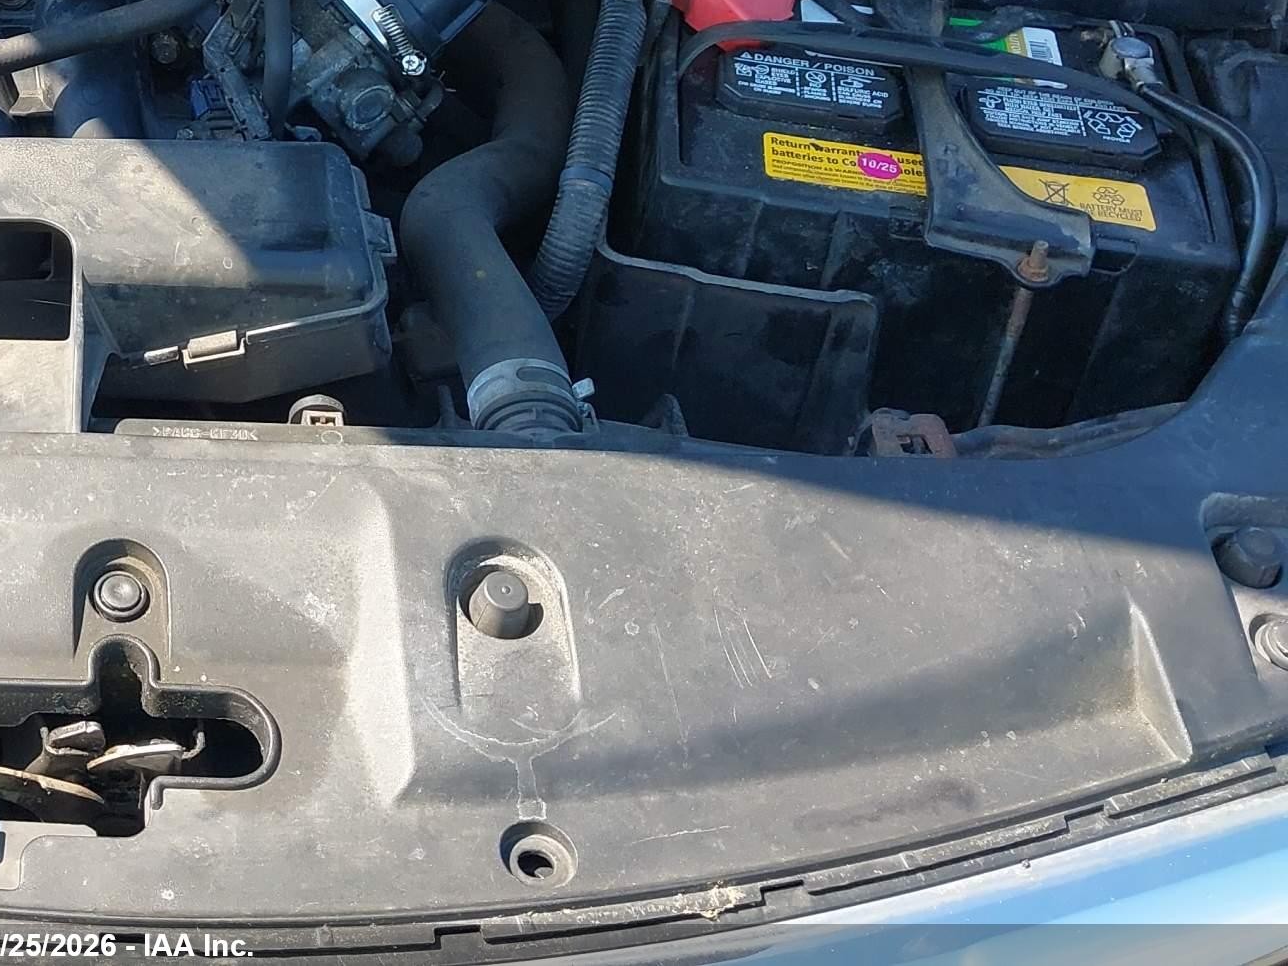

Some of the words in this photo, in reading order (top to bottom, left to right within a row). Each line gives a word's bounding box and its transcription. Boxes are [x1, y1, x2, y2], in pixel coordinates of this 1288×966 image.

[754, 53, 809, 67] DANGER
[824, 63, 875, 76] POISON
[771, 137, 810, 151] Return
[772, 147, 824, 162] batteries
[862, 157, 898, 173] 10/25
[1080, 202, 1117, 212] BATTERY
